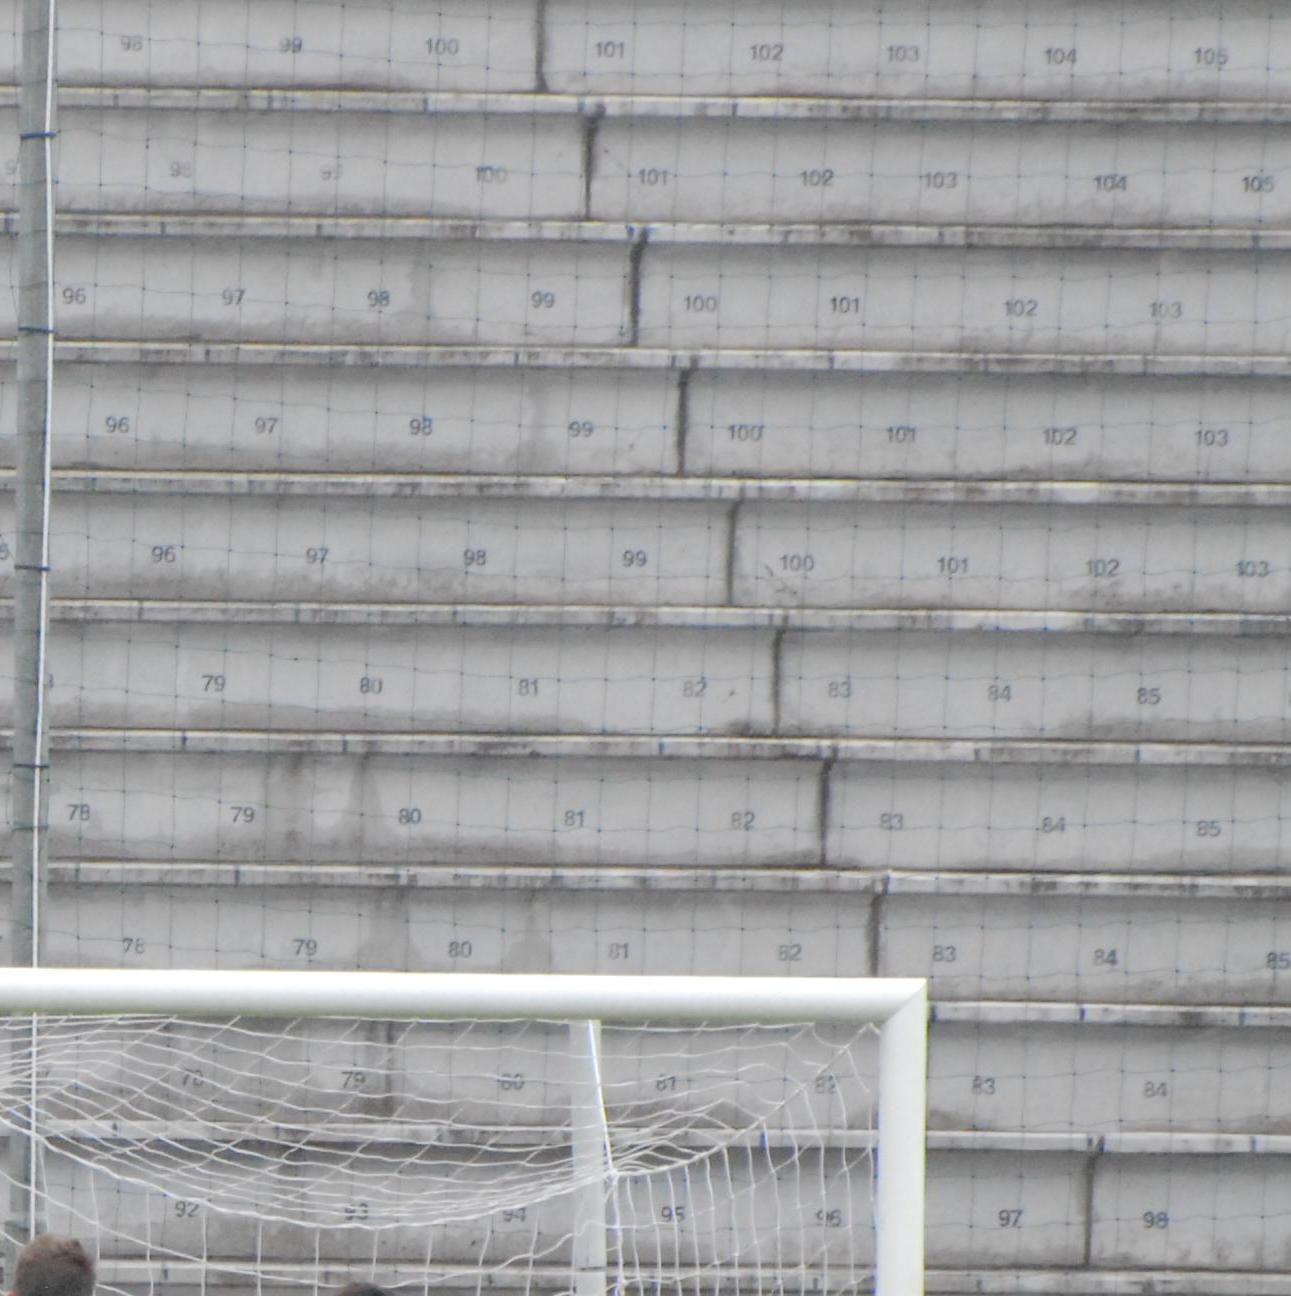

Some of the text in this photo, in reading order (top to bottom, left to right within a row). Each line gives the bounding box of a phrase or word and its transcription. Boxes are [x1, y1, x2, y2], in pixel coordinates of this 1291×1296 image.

[426, 38, 460, 56] 100
[596, 41, 626, 58] 101
[751, 43, 785, 62] 102
[1045, 48, 1078, 66] 104
[1195, 48, 1229, 66] 105
[637, 169, 669, 186] 101
[923, 172, 959, 189] 103
[63, 287, 87, 305] 96
[222, 288, 246, 306] 97
[367, 290, 391, 308] 98
[531, 291, 557, 309] 99
[685, 295, 720, 313] 100
[830, 296, 861, 315] 101
[1005, 300, 1039, 318] 102
[105, 416, 130, 433] 96
[255, 417, 280, 434] 97
[409, 418, 434, 437] 98
[567, 421, 596, 438] 99
[1196, 429, 1230, 447] 103
[152, 544, 176, 563] 96
[306, 546, 330, 566] 97
[463, 548, 488, 568] 98
[622, 550, 649, 568] 99
[781, 554, 816, 572] 100
[938, 556, 969, 576] 101
[202, 674, 227, 693] 79
[359, 676, 384, 695] 80
[517, 677, 539, 697] 81
[988, 685, 1013, 703] 84
[1137, 687, 1162, 706] 85
[70, 804, 92, 822] 78
[232, 807, 256, 823] 79
[565, 810, 586, 827] 81
[879, 813, 906, 832] 83
[1041, 817, 1067, 835] 84
[292, 937, 317, 958] 79
[448, 941, 473, 959] 80
[932, 945, 957, 963] 83
[1266, 951, 1291, 971] 85
[998, 1209, 1024, 1230] 97
[1142, 1211, 1171, 1231] 98
